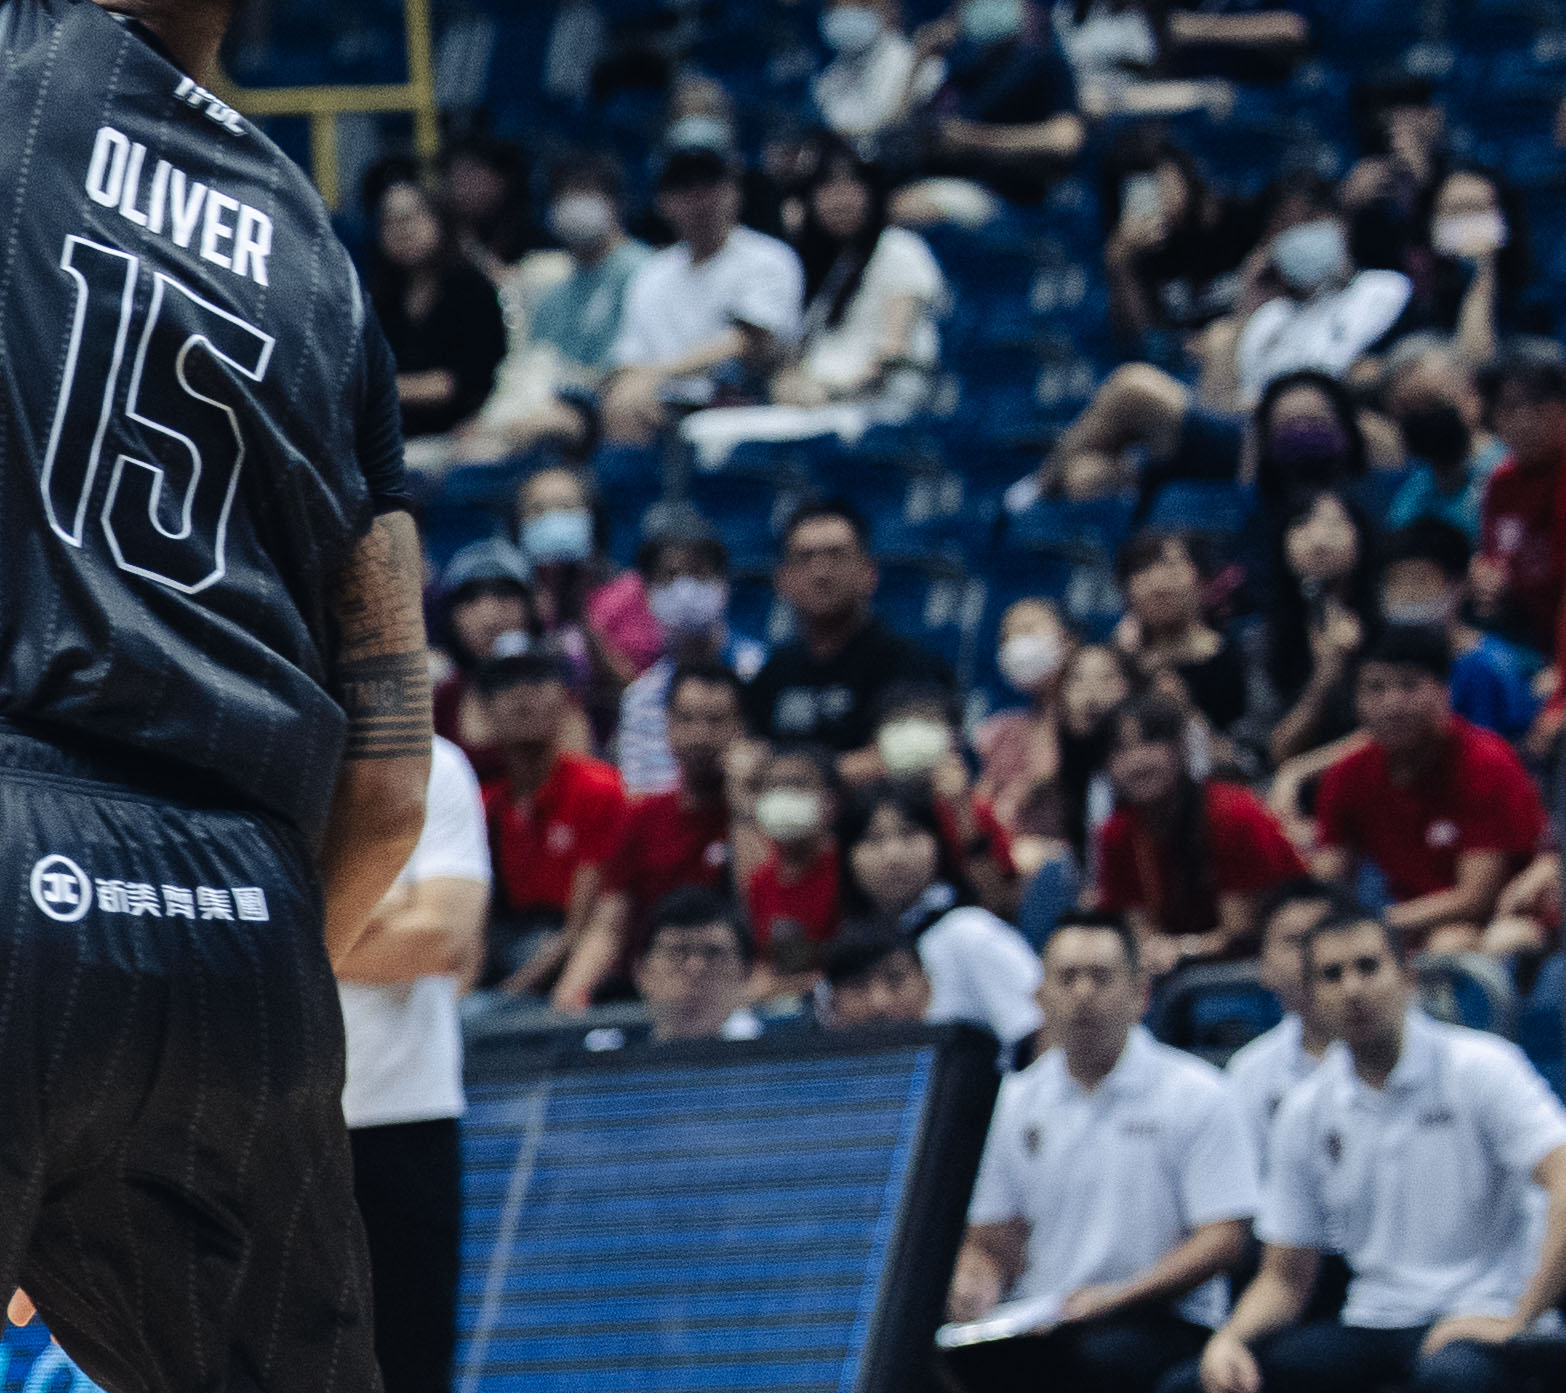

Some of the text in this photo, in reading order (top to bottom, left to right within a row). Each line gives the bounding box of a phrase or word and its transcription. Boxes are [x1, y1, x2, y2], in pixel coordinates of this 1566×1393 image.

[85, 126, 272, 286] OLIVER
[40, 233, 277, 594] 15
[94, 876, 271, 922] 新美齊集團
